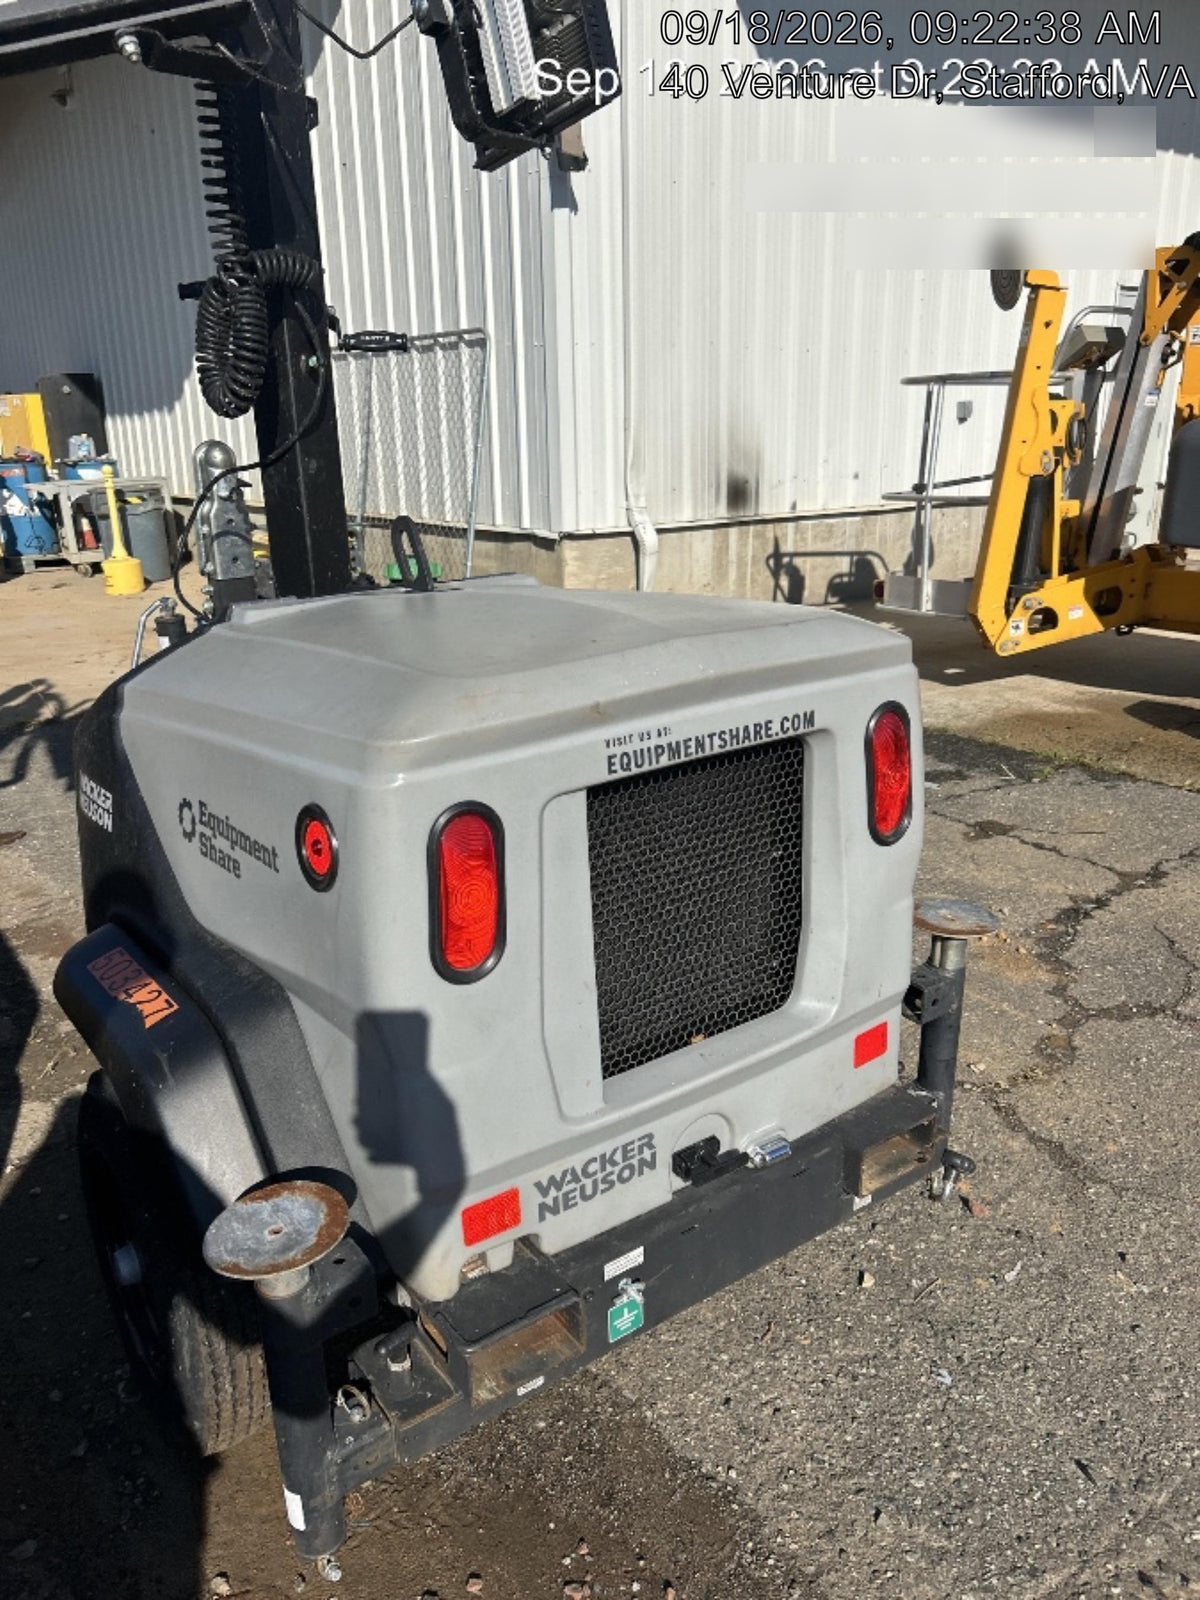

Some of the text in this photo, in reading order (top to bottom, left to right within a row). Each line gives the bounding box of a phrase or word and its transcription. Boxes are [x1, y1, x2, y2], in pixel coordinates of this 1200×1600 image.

[604, 732, 634, 748] VISIT
[607, 709, 816, 775] EQUIPMENTSHARE.COM
[199, 800, 280, 874] Equipment
[199, 833, 241, 879] Share
[90, 950, 175, 1021] 503427
[533, 1132, 657, 1199] WACKER
[537, 1149, 657, 1222] NEUSON
